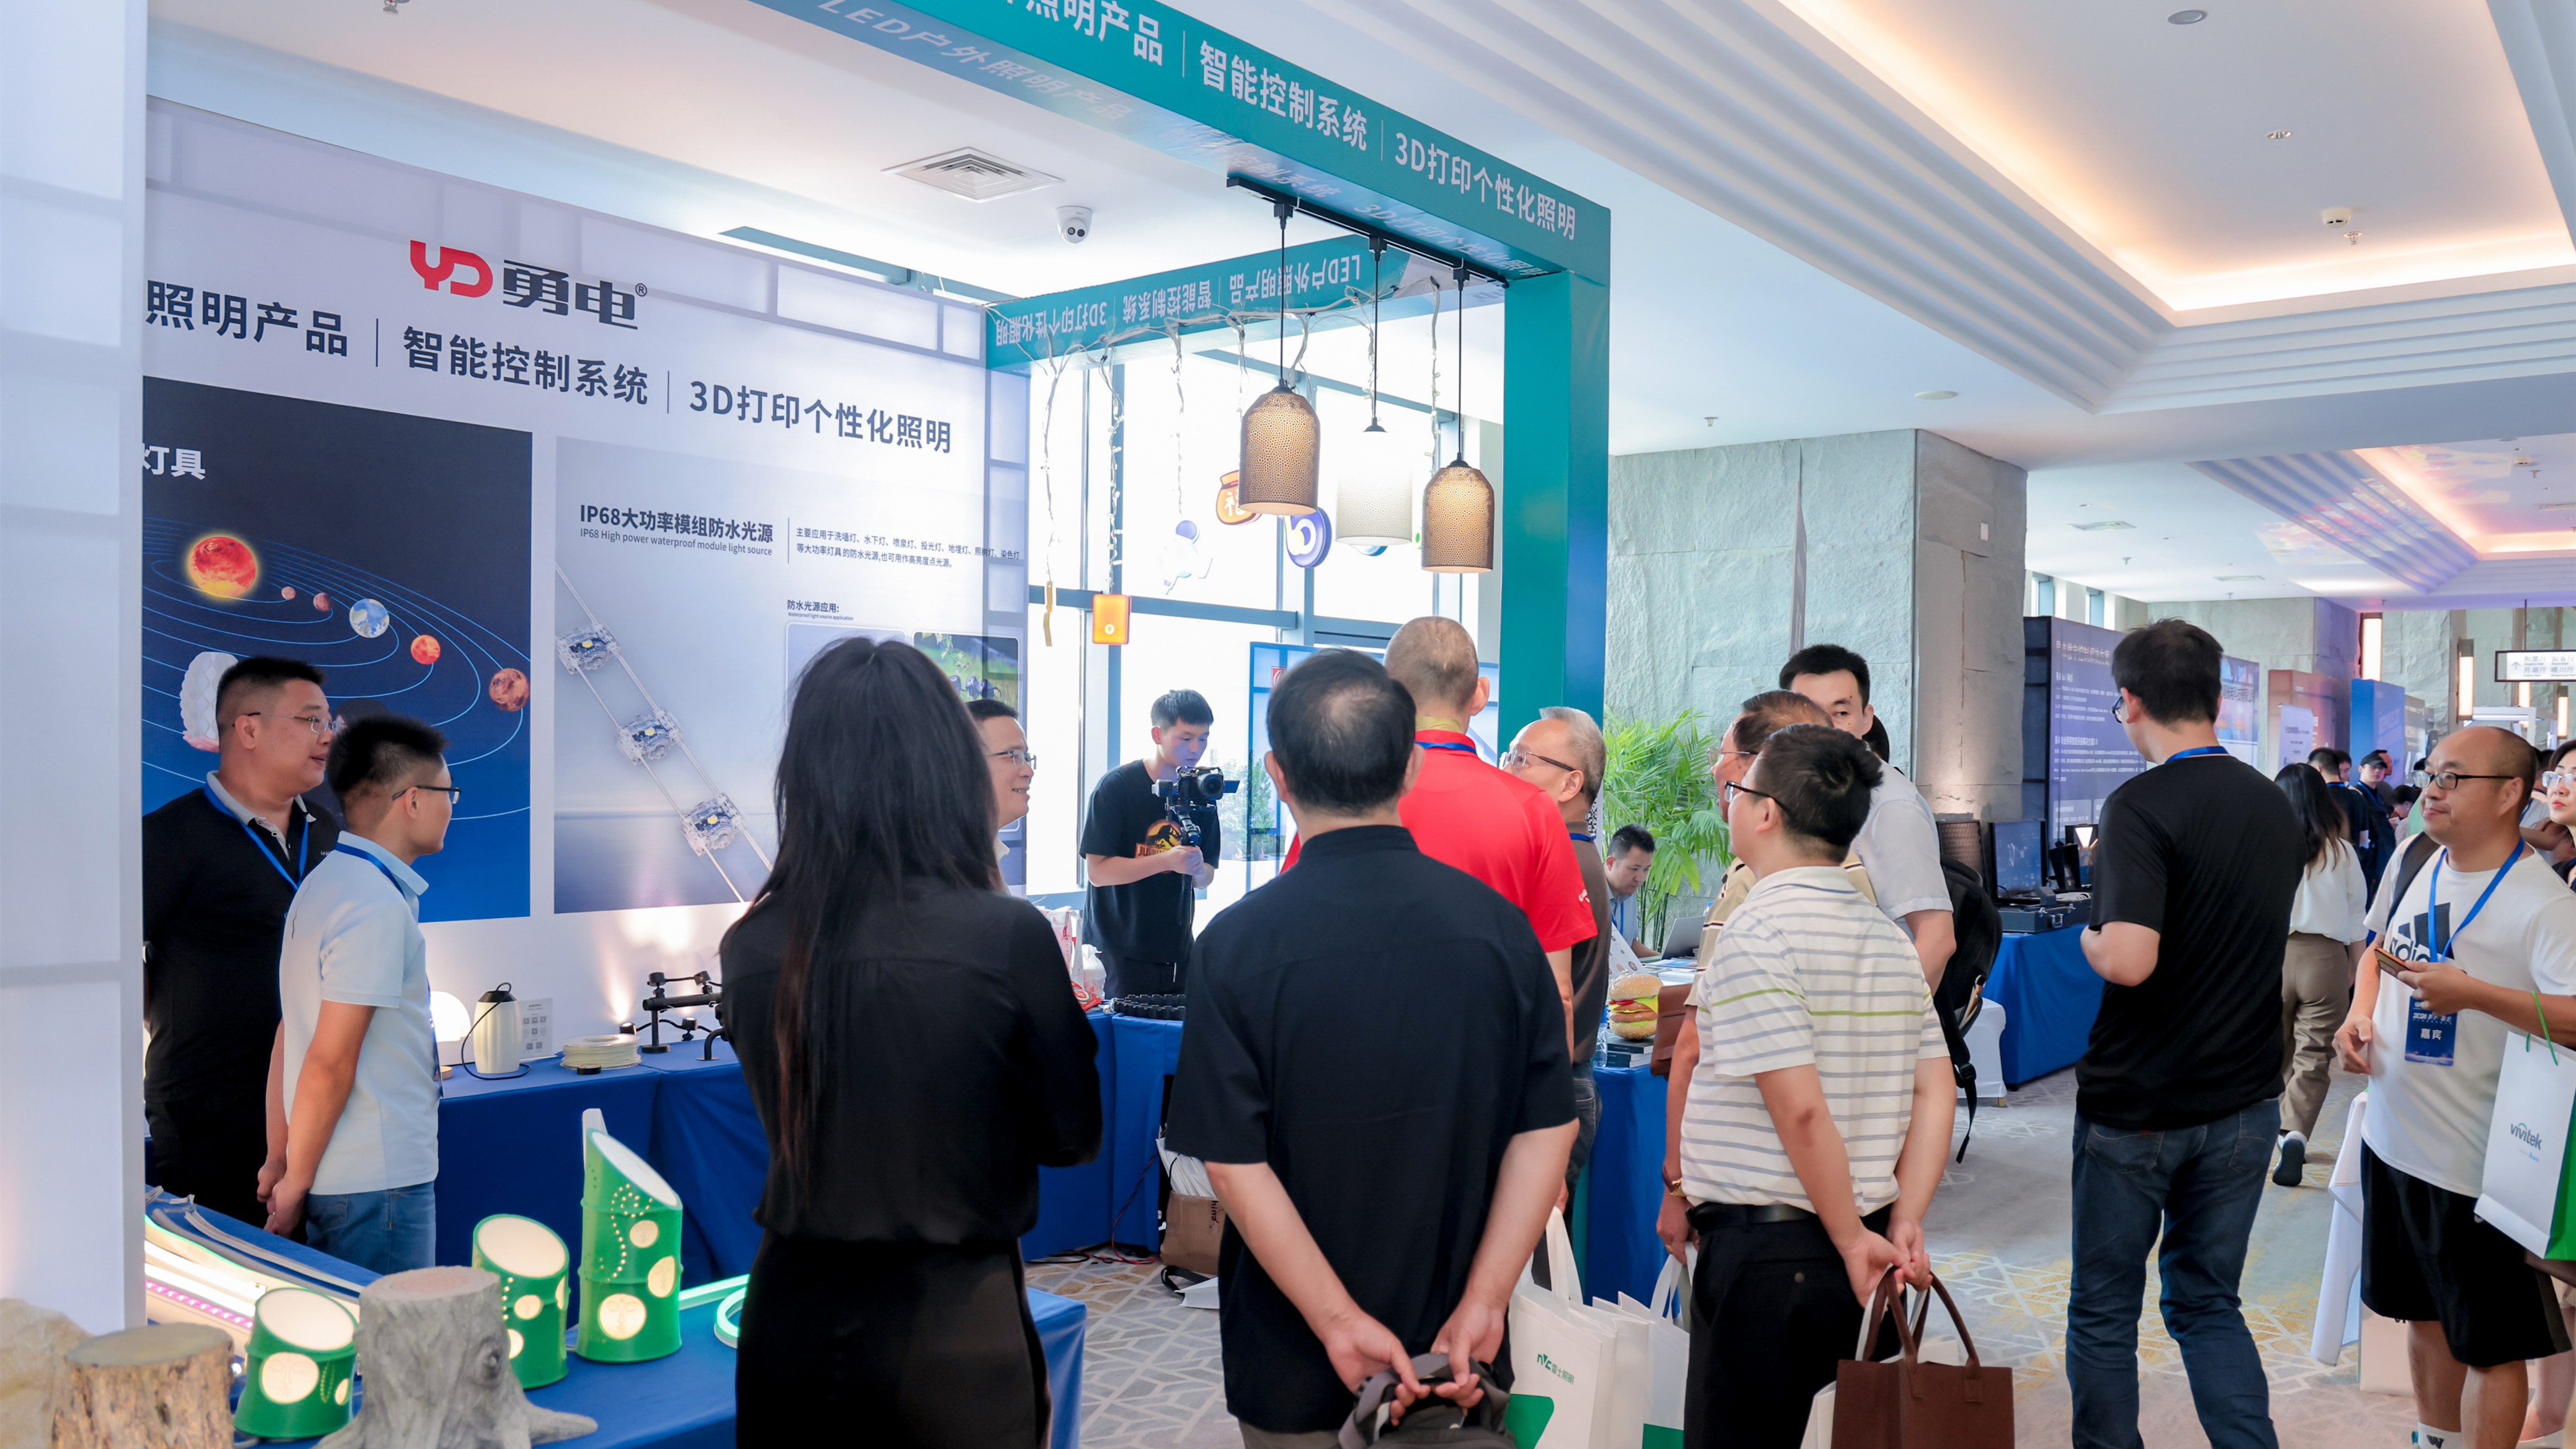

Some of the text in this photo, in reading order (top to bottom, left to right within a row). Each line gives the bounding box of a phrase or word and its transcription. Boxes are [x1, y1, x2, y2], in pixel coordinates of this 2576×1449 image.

[1200, 40, 1367, 151] 智能控制系统
[1395, 132, 1576, 241] 3D打印个性化照明
[996, 254, 1361, 346] LED户外照明产品 智能控制系统 3D打印个性化照明
[146, 279, 952, 454] 照明产品 智能控制系统 3D打印个性化照明
[580, 505, 774, 544] IP68大功率模组防水光源
[580, 528, 772, 555] IP68 High power waterproof module light source
[2510, 1123, 2542, 1151] vivitek
